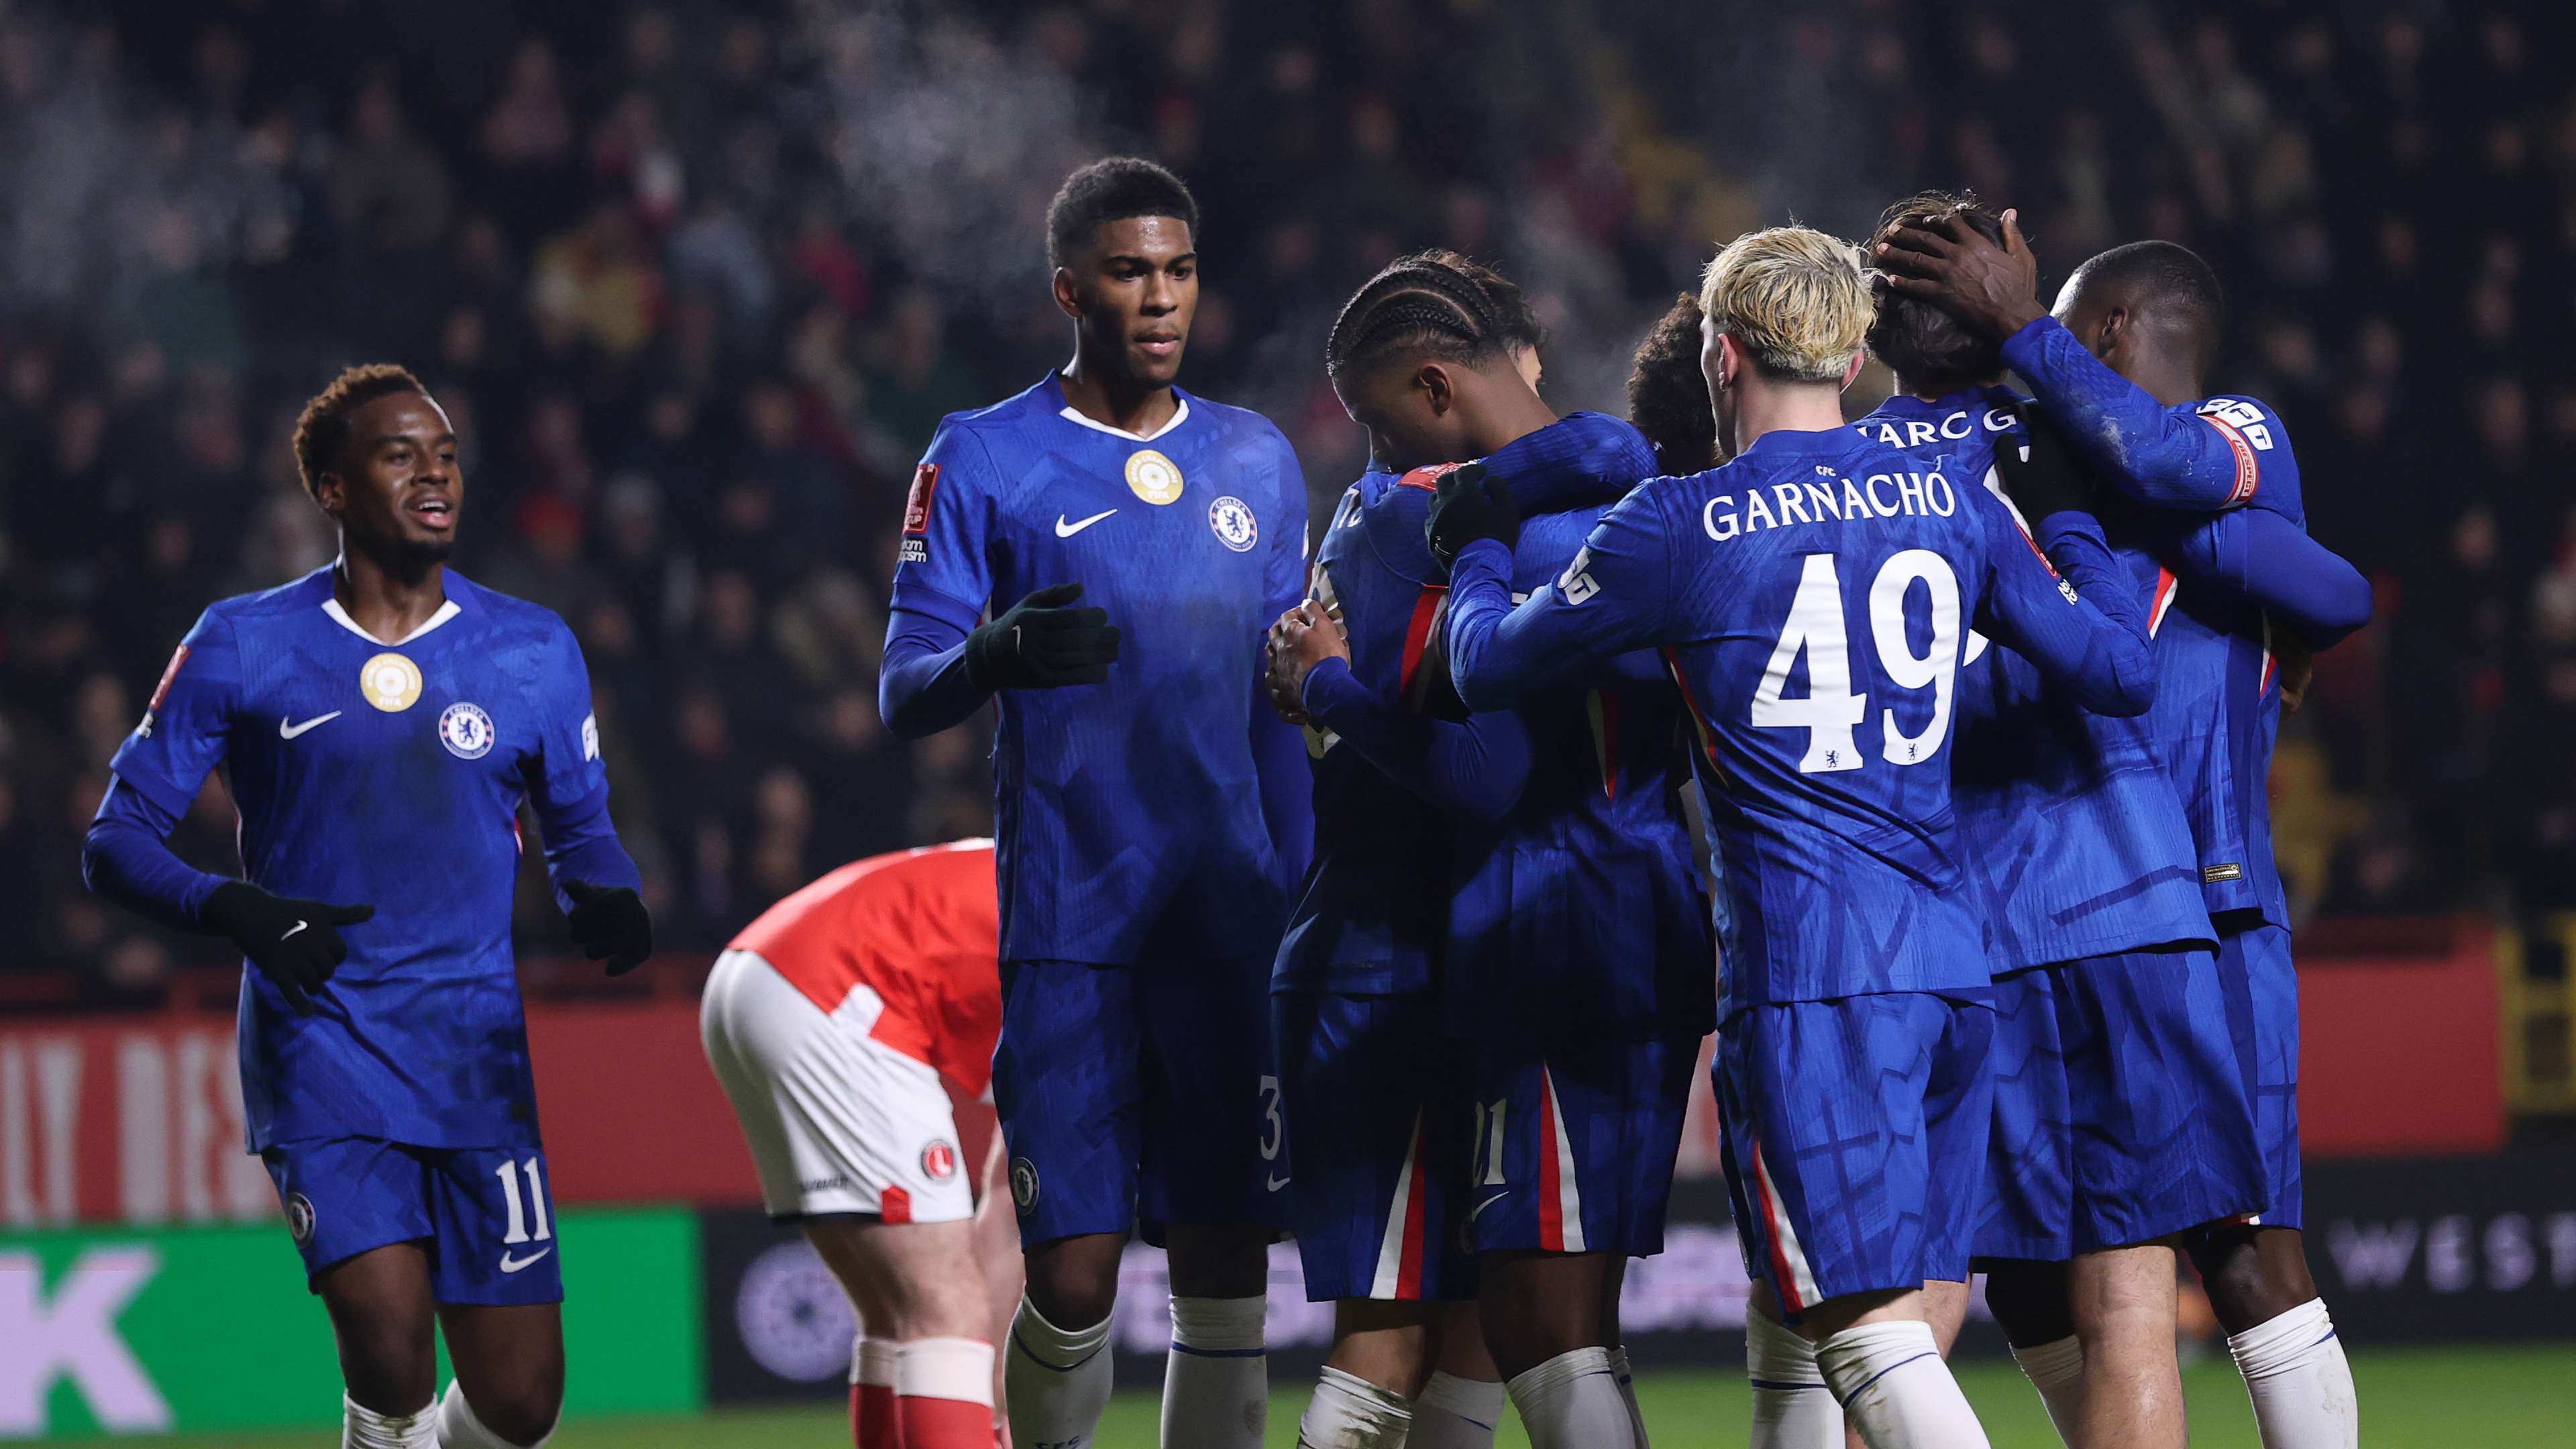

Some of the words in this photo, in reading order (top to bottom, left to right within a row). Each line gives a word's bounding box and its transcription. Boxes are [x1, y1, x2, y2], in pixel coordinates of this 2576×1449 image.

[1857, 411, 1972, 449] ARC
[1815, 466, 1837, 477] CFC
[1215, 498, 1246, 514] CHELSEA
[1703, 472, 1955, 541] GARNACHO
[1751, 549, 1961, 773] 49
[496, 1157, 551, 1244] 11
